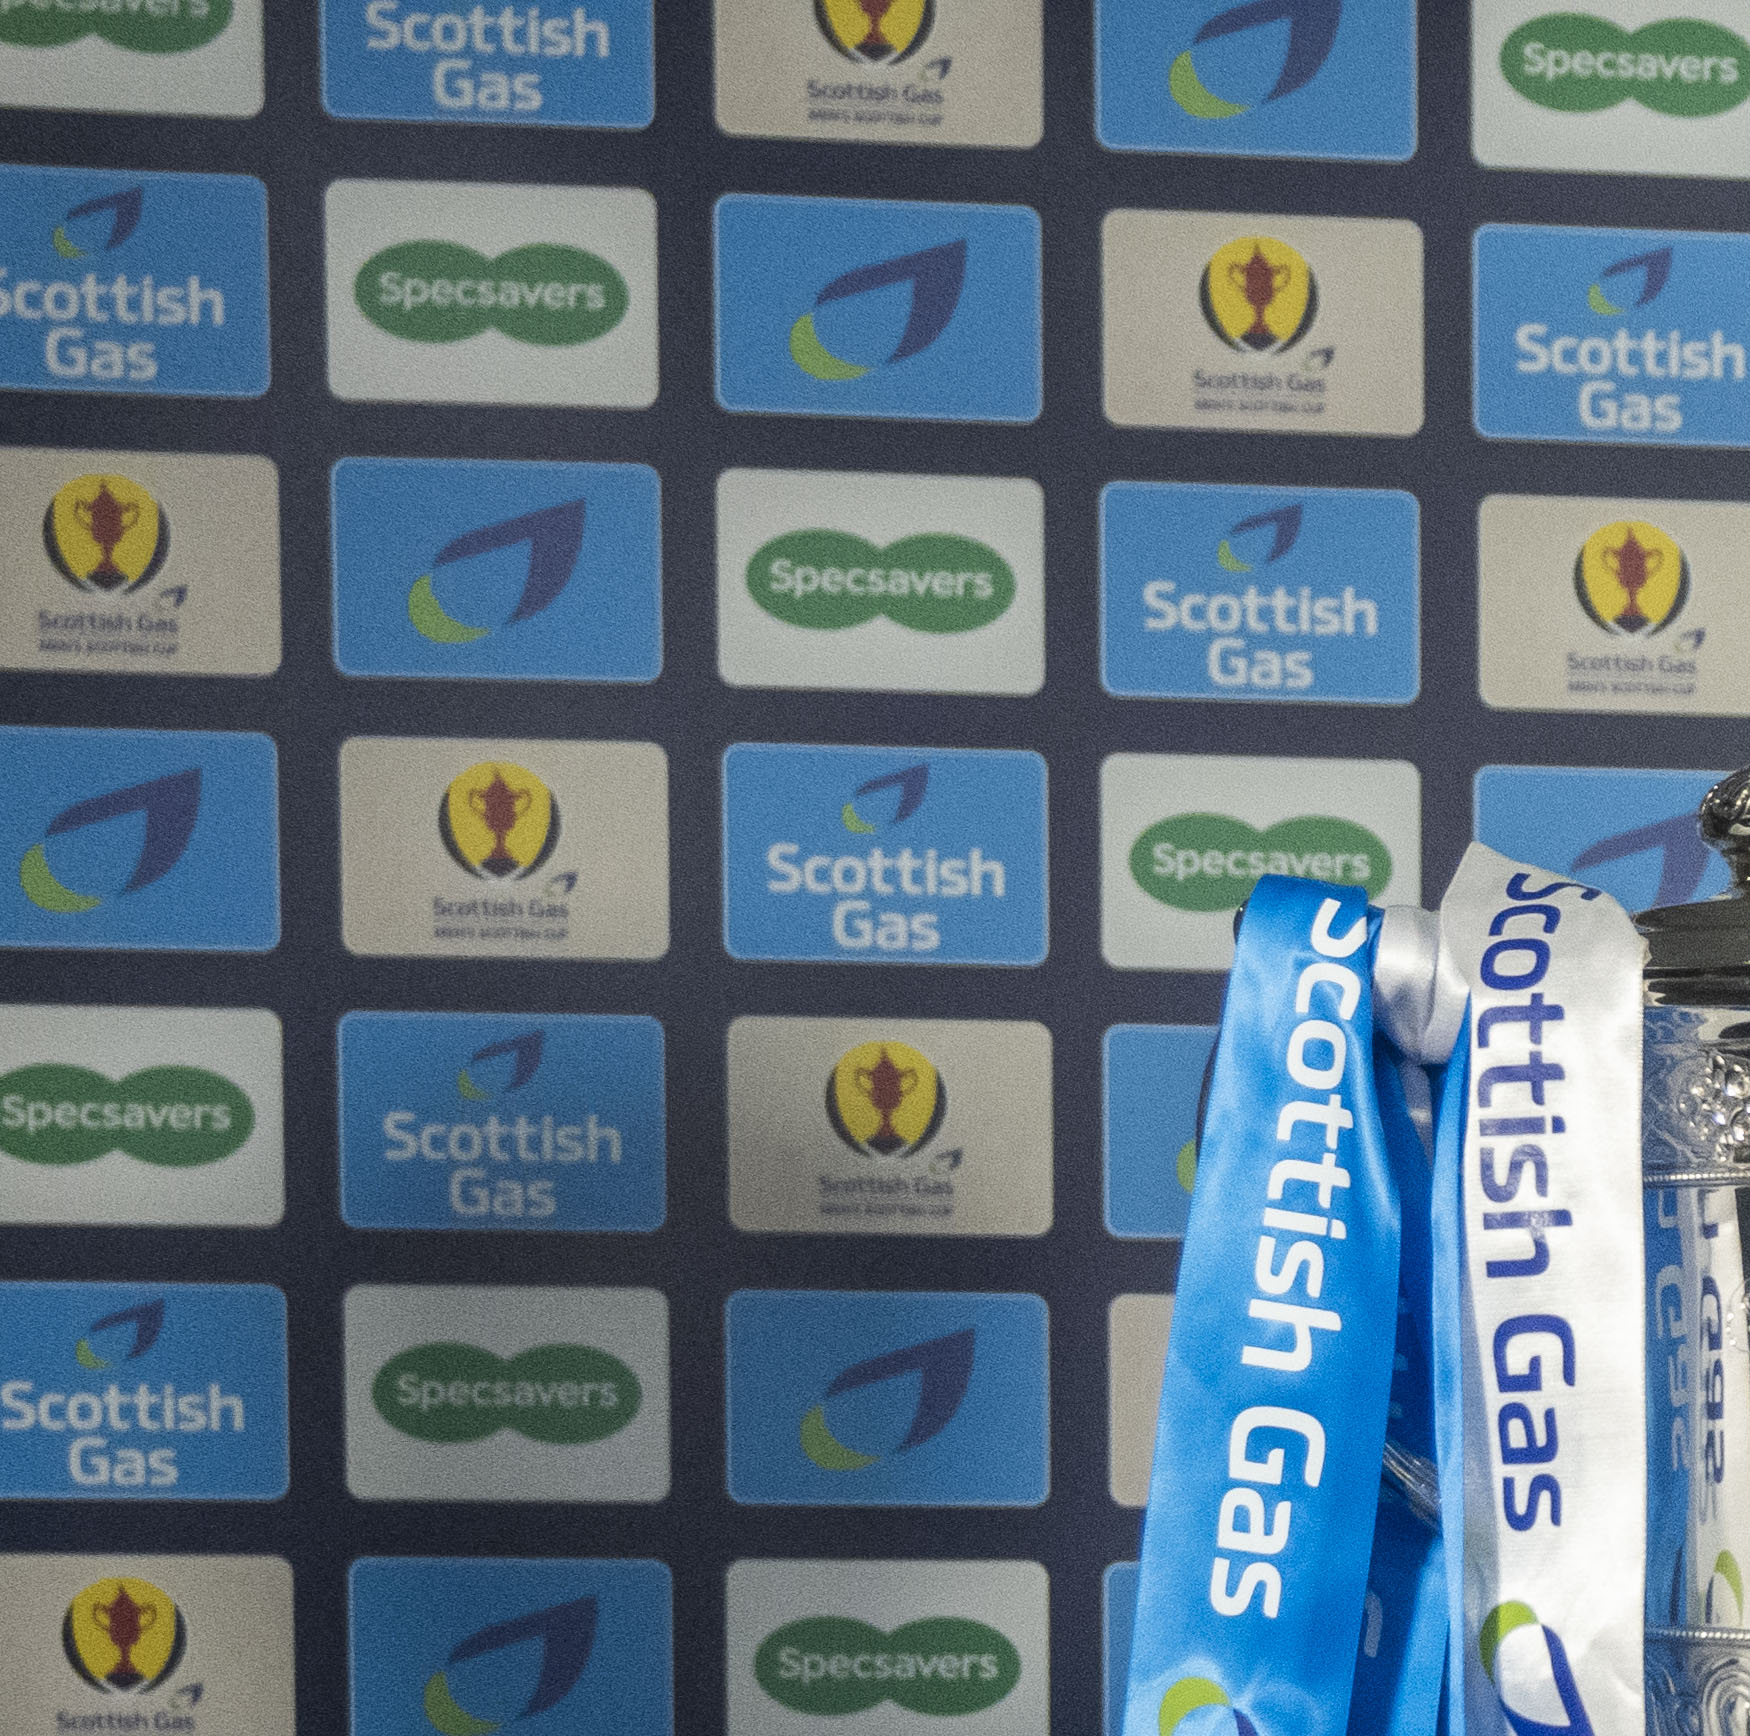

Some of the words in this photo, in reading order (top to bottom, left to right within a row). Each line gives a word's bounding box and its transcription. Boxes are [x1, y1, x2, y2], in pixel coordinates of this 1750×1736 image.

[366, 0, 609, 57] Scottish
[433, 59, 542, 111] Gas
[1523, 42, 1739, 84] Specsavers
[379, 272, 605, 310] Specsavers
[45, 327, 157, 381] Gas
[1515, 324, 1746, 379] Scottish
[1579, 380, 1682, 432] Gas
[770, 559, 994, 599] Specsavers
[1143, 581, 1378, 635] Scottish
[1208, 637, 1313, 689] Gas
[767, 843, 1005, 897] Scottish
[1153, 842, 1371, 881] Specsavers
[833, 899, 940, 951] Gas
[1477, 872, 1600, 1278] Scottish
[0, 1094, 231, 1133] Specsavers
[383, 1110, 621, 1162] Scottish
[1241, 895, 1367, 1373] Scottish
[450, 1167, 555, 1217] Gas
[0, 1381, 243, 1432] Scottish
[397, 1374, 619, 1410] Specsavers
[1491, 1314, 1575, 1532] Gas
[68, 1435, 177, 1486] Gas
[1210, 1405, 1325, 1619] Gas
[779, 1648, 999, 1682] Specsavers
